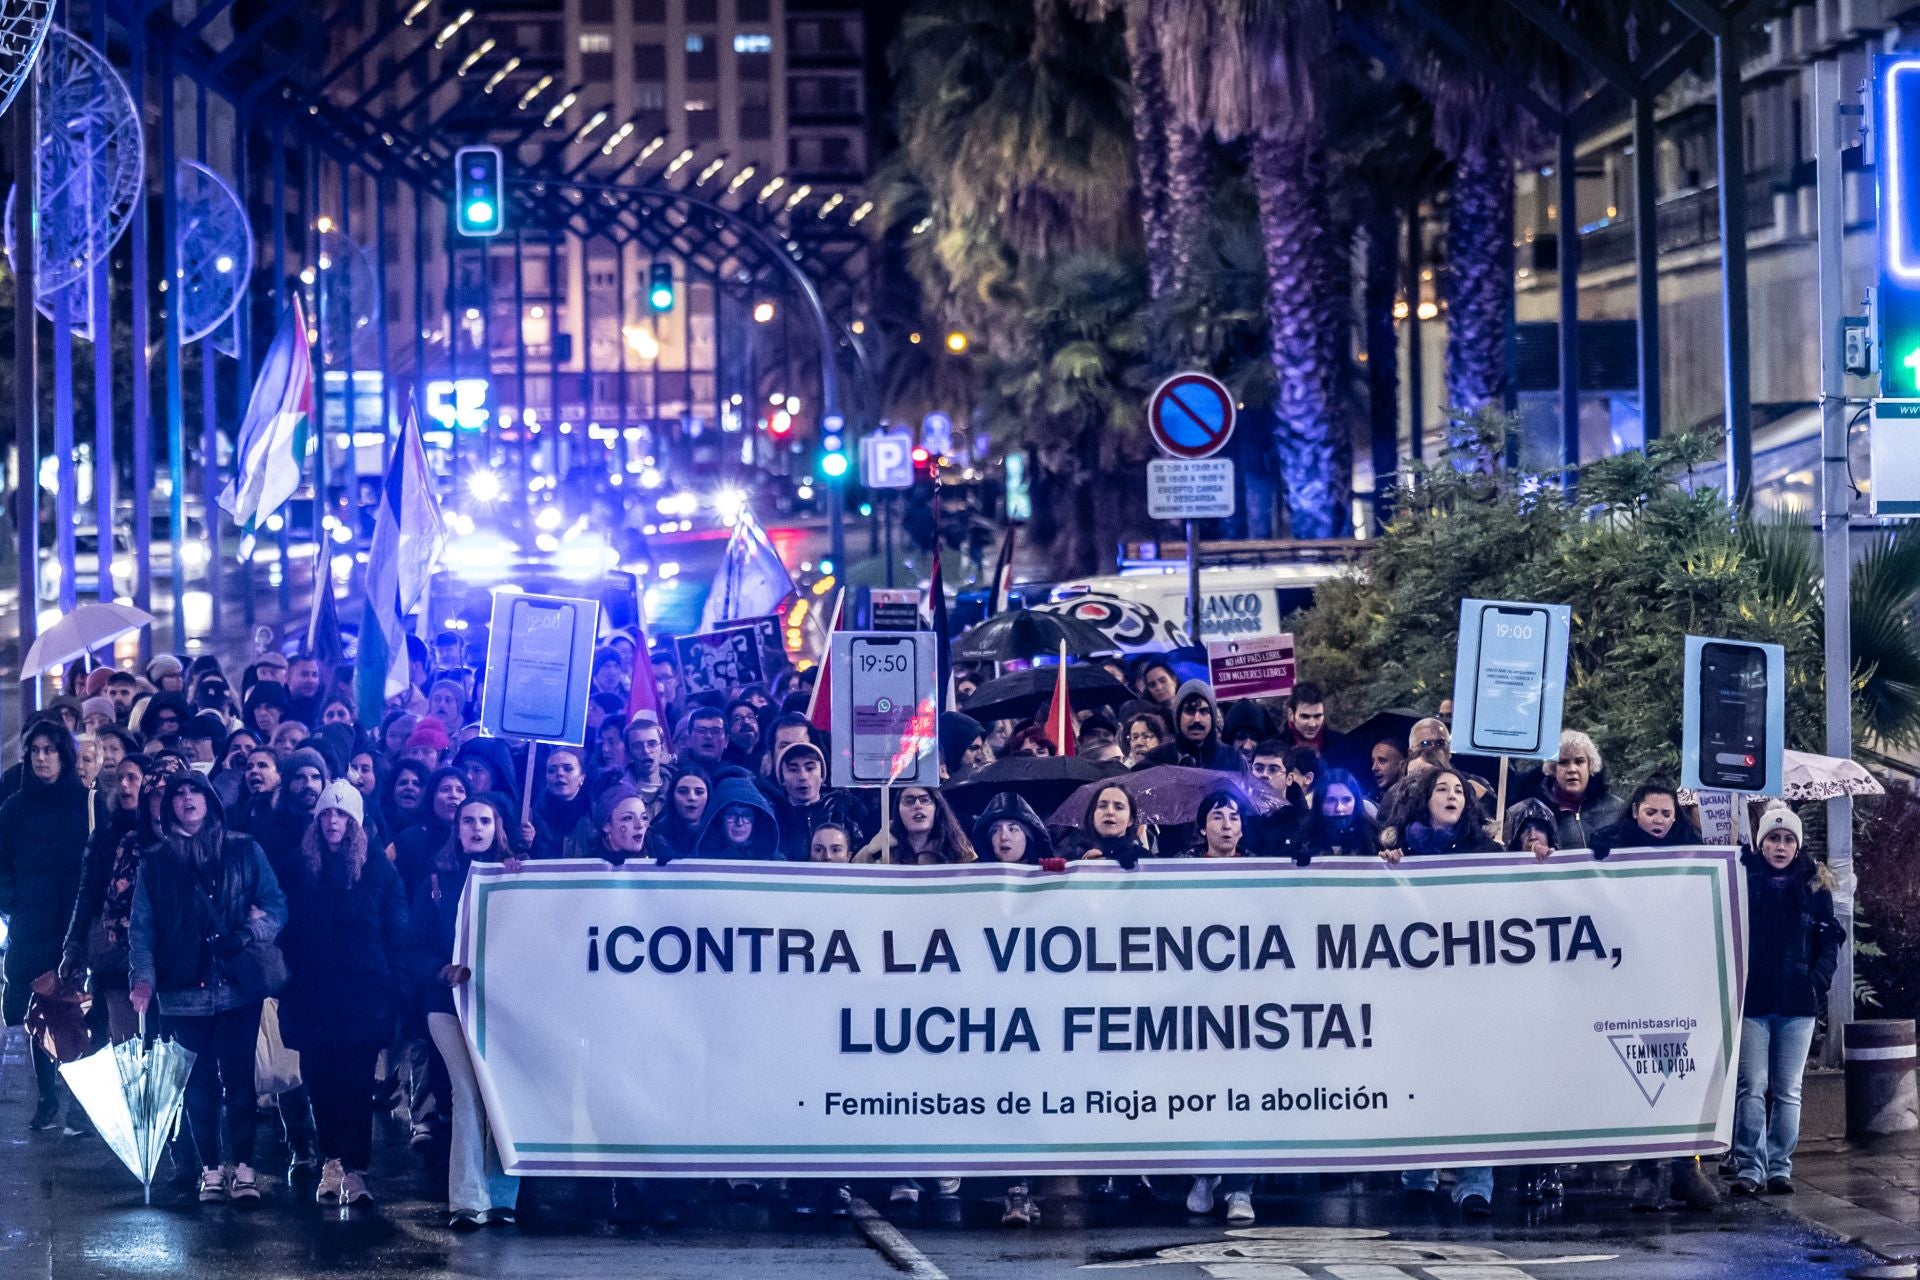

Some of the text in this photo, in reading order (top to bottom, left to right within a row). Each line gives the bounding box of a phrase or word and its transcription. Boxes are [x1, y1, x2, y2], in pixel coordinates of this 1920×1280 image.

[876, 442, 903, 482] P
[1496, 624, 1532, 640] 19:00
[859, 654, 908, 673] 19:50
[1225, 658, 1234, 667] NO
[1234, 655, 1247, 666] HAY
[1218, 666, 1288, 682] SIN MUJERES LIBRES
[586, 915, 1623, 974] ¡CONTRA LA VIOLENCIA MACHISTA,
[839, 1003, 1373, 1054] LUCHA FEMINISTA!
[1593, 1017, 1697, 1032] @feministasrioja
[1626, 1042, 1688, 1060] FEMINISTAS
[1636, 1058, 1696, 1077] DE LA RIOJA
[824, 1085, 1389, 1120] Feministas de La Rioja por la abolición
